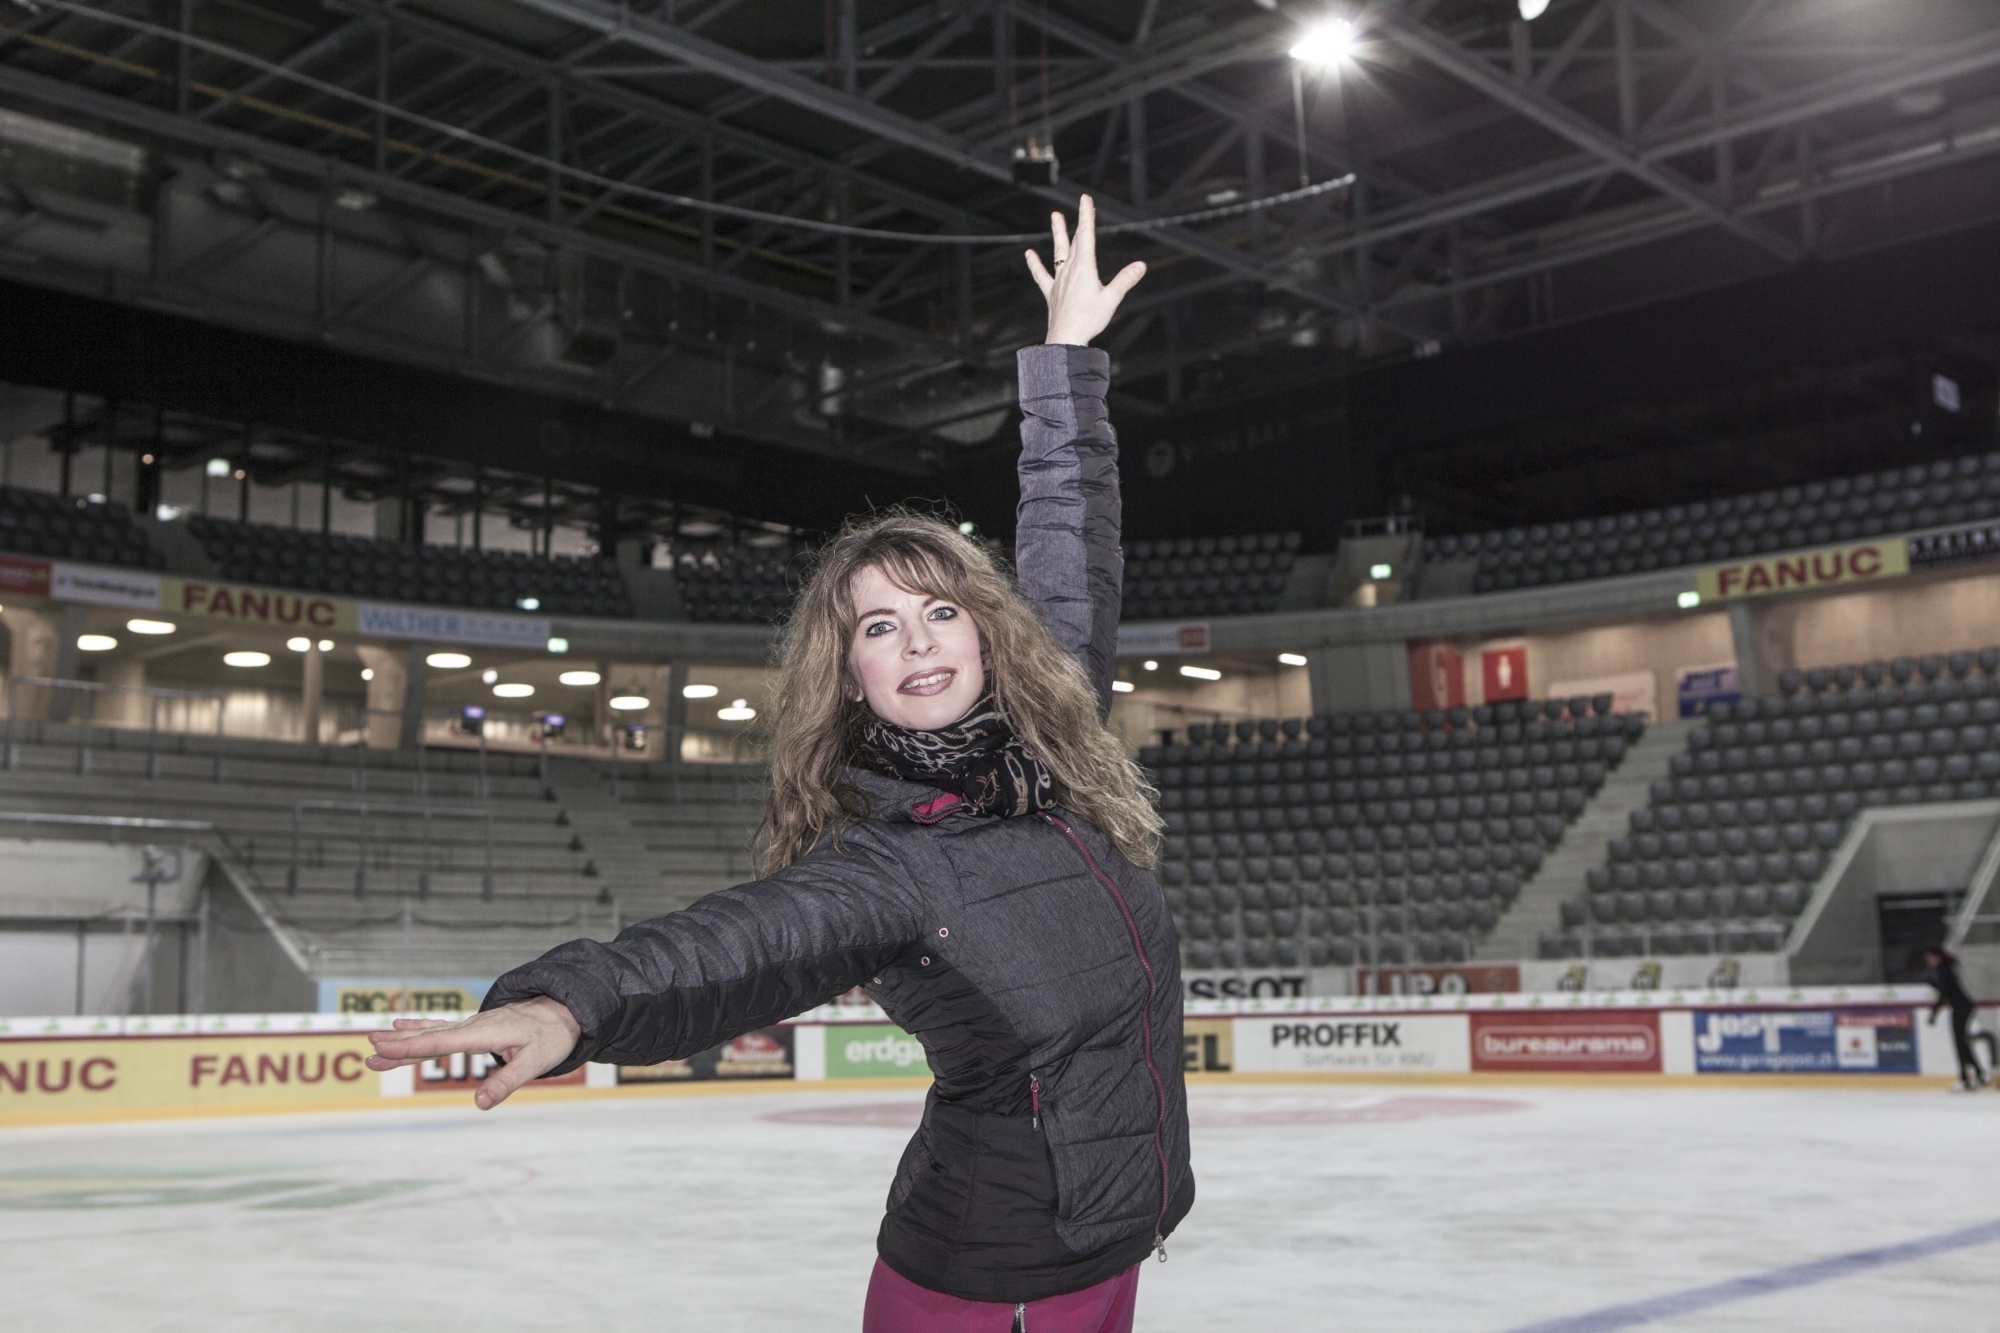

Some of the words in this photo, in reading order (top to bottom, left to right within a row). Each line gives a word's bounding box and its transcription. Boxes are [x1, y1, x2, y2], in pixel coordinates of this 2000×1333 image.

[1718, 546, 1882, 596] FANUC
[183, 584, 336, 627] FANUC
[1184, 976, 1305, 998] SSOT
[1272, 1022, 1402, 1047] PROFFIX
[1484, 1034, 1647, 1054] bureaurama
[190, 1051, 365, 1088] FANUC
